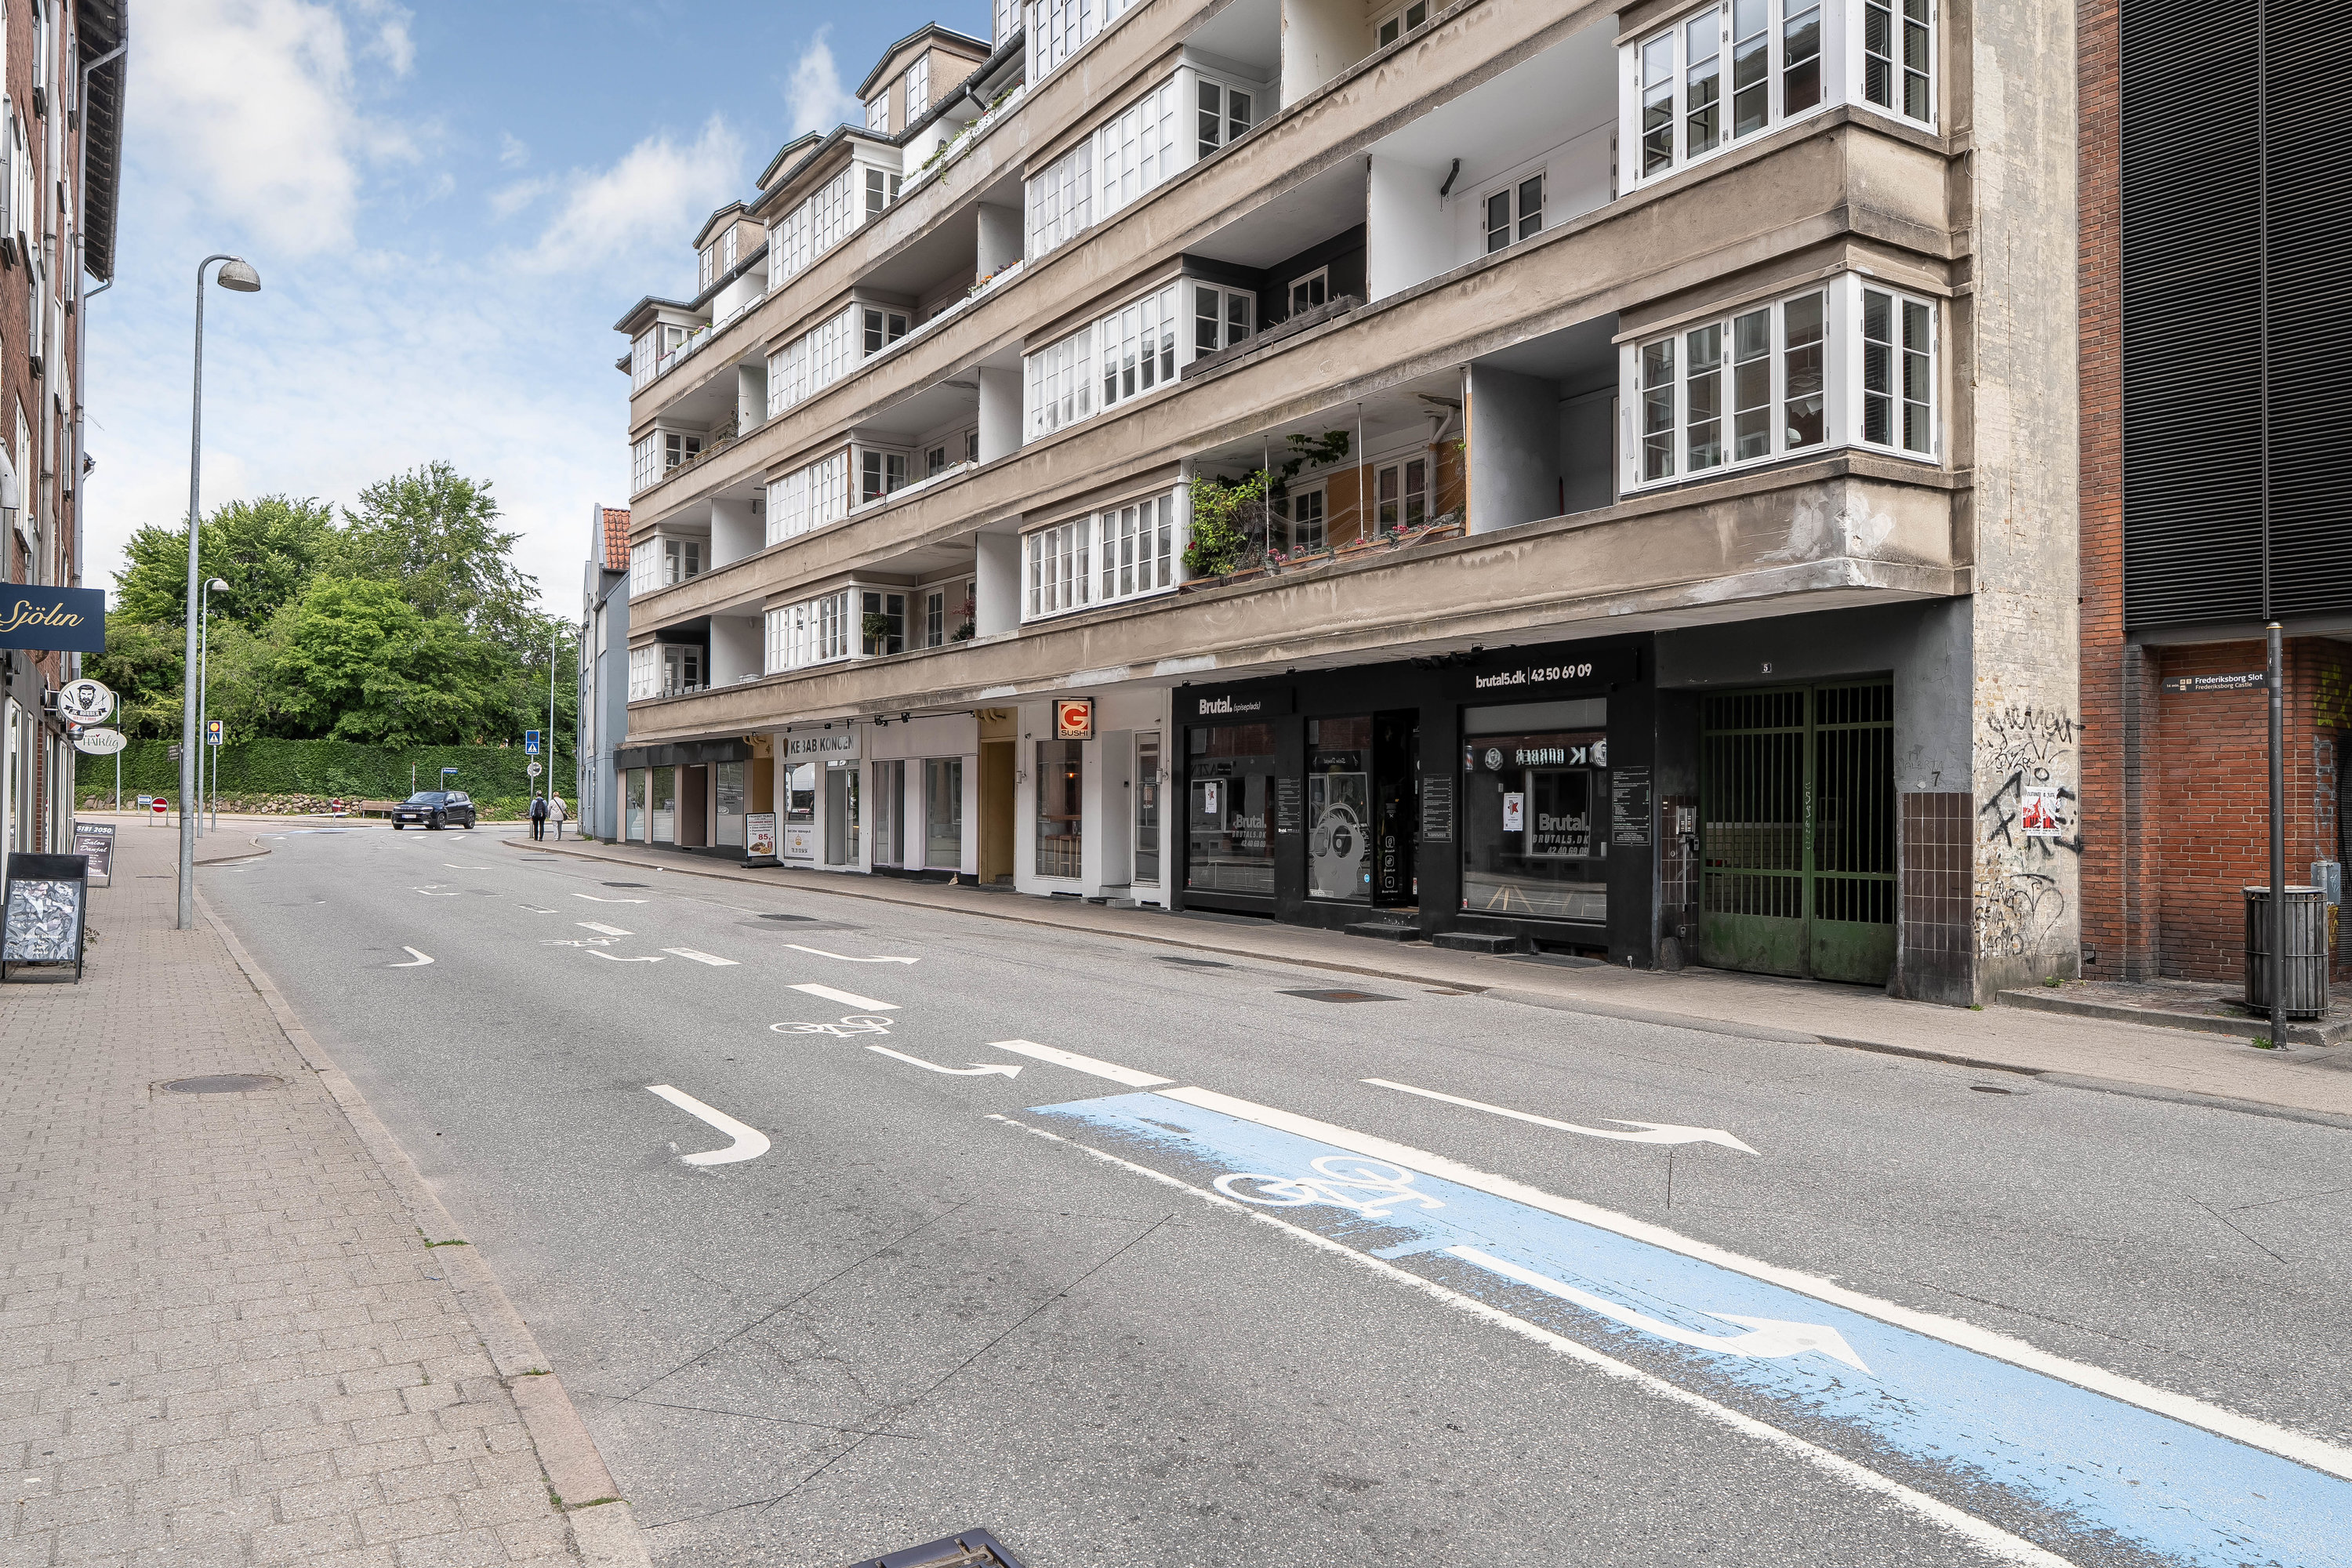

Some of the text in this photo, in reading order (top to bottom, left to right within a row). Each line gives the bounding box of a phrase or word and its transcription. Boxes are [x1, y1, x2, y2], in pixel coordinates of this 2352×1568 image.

[1475, 663, 1592, 688] brutal5.dk 42 50 69 09
[2195, 675, 2246, 684] Frederiksborg
[1200, 695, 1261, 715] Brutal. (spiseplads)
[83, 735, 118, 752] HAIRlig
[1932, 771, 1941, 786] 7
[1236, 813, 1267, 829] Brutal.
[1539, 812, 1590, 831] Brutal.
[1532, 834, 1589, 844] BRUTAL5.DK
